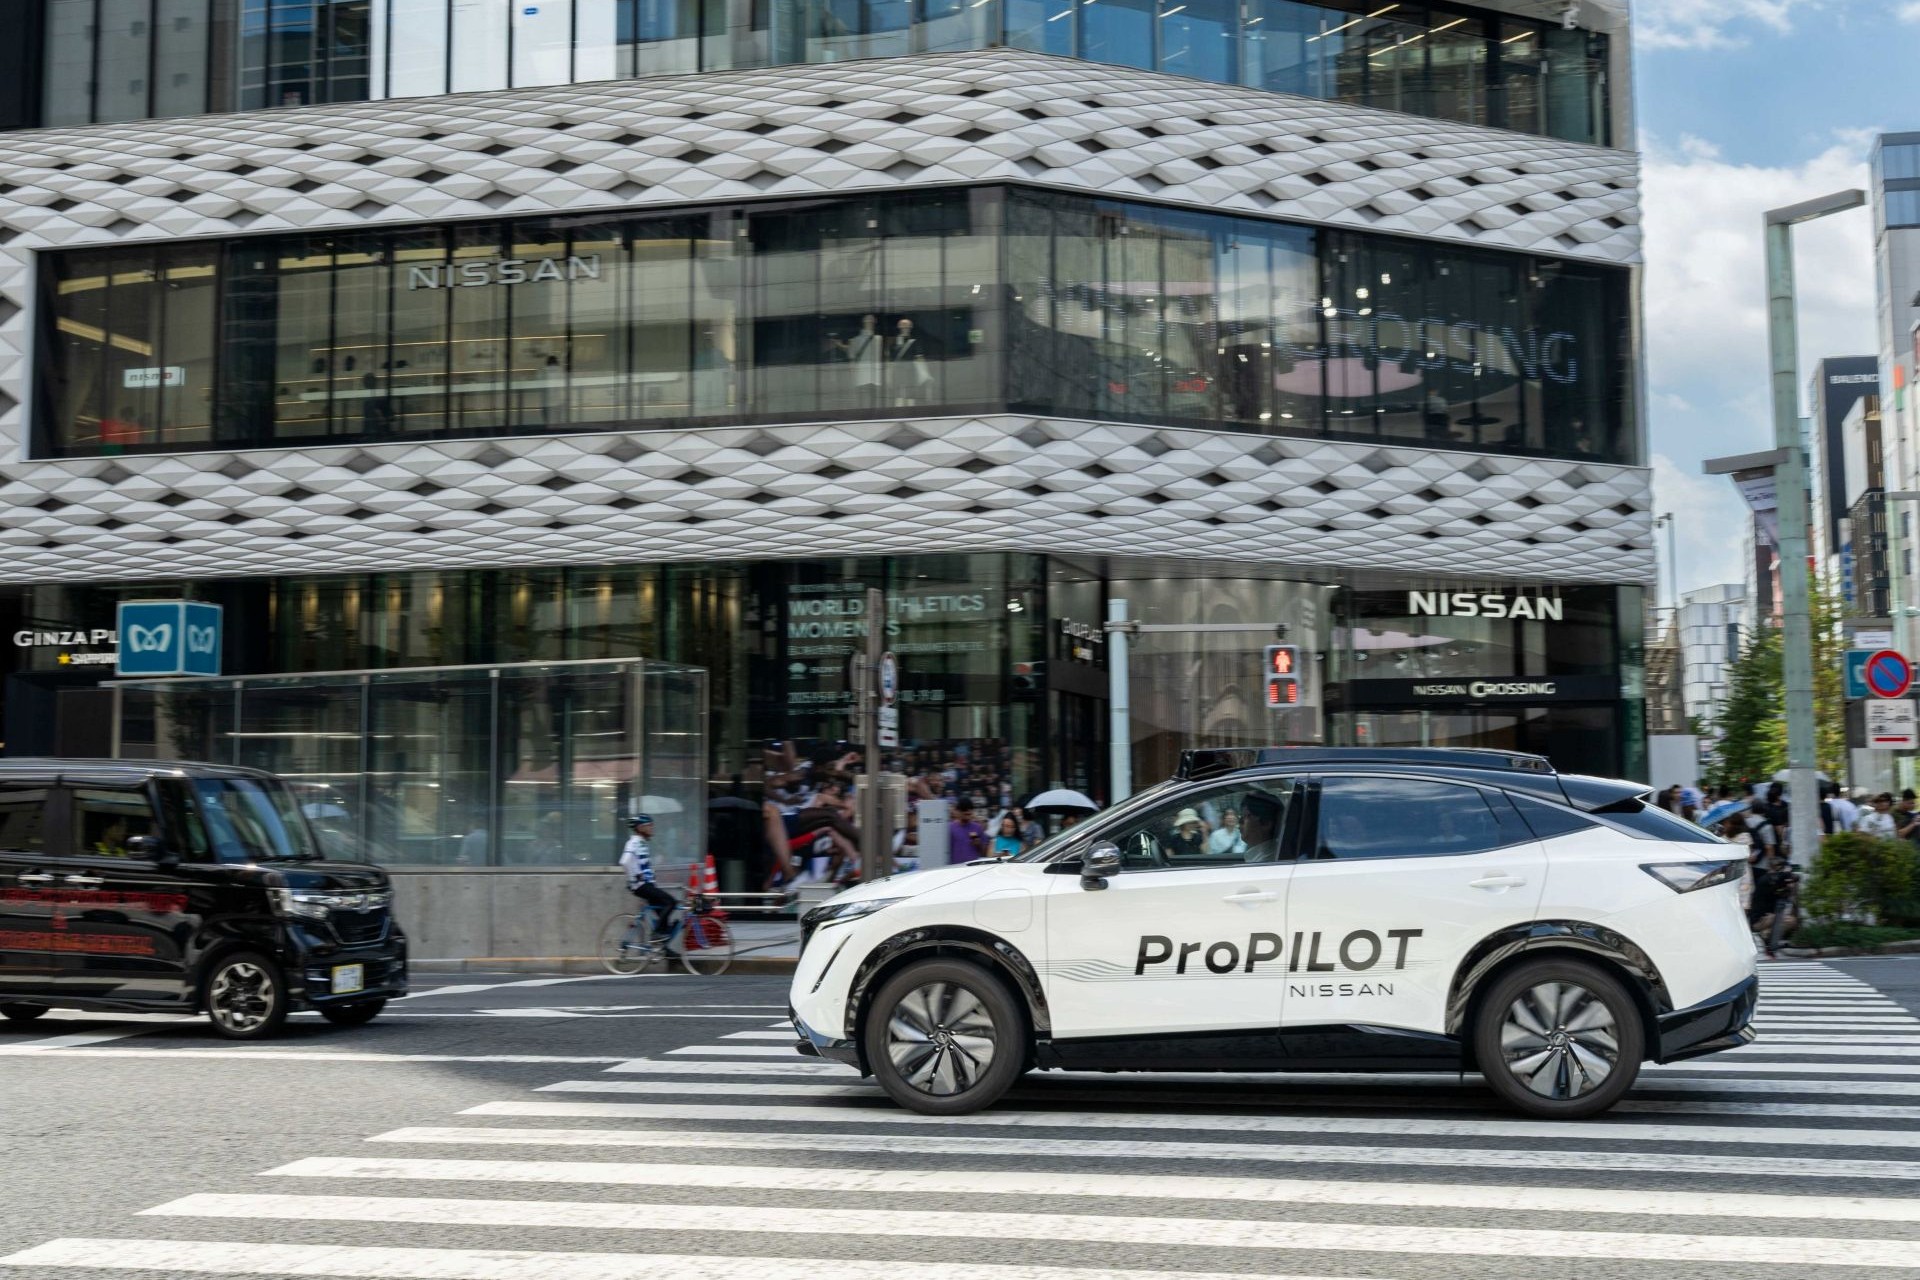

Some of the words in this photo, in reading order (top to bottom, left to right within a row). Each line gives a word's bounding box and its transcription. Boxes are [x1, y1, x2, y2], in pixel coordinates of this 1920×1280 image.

[408, 254, 601, 291] NISSAN
[1274, 299, 1578, 384] CROSSING
[788, 599, 865, 617] WORLD
[886, 595, 985, 614] THLETICS
[1409, 591, 1563, 620] NISSAN
[13, 630, 88, 647] GINZA
[91, 629, 119, 645] PL
[787, 618, 901, 638] MOMENS
[1413, 684, 1467, 696] NISSAN
[1468, 681, 1557, 698] CROSSING
[1135, 928, 1424, 976] ProPILOT
[1290, 983, 1395, 998] NISSAN
